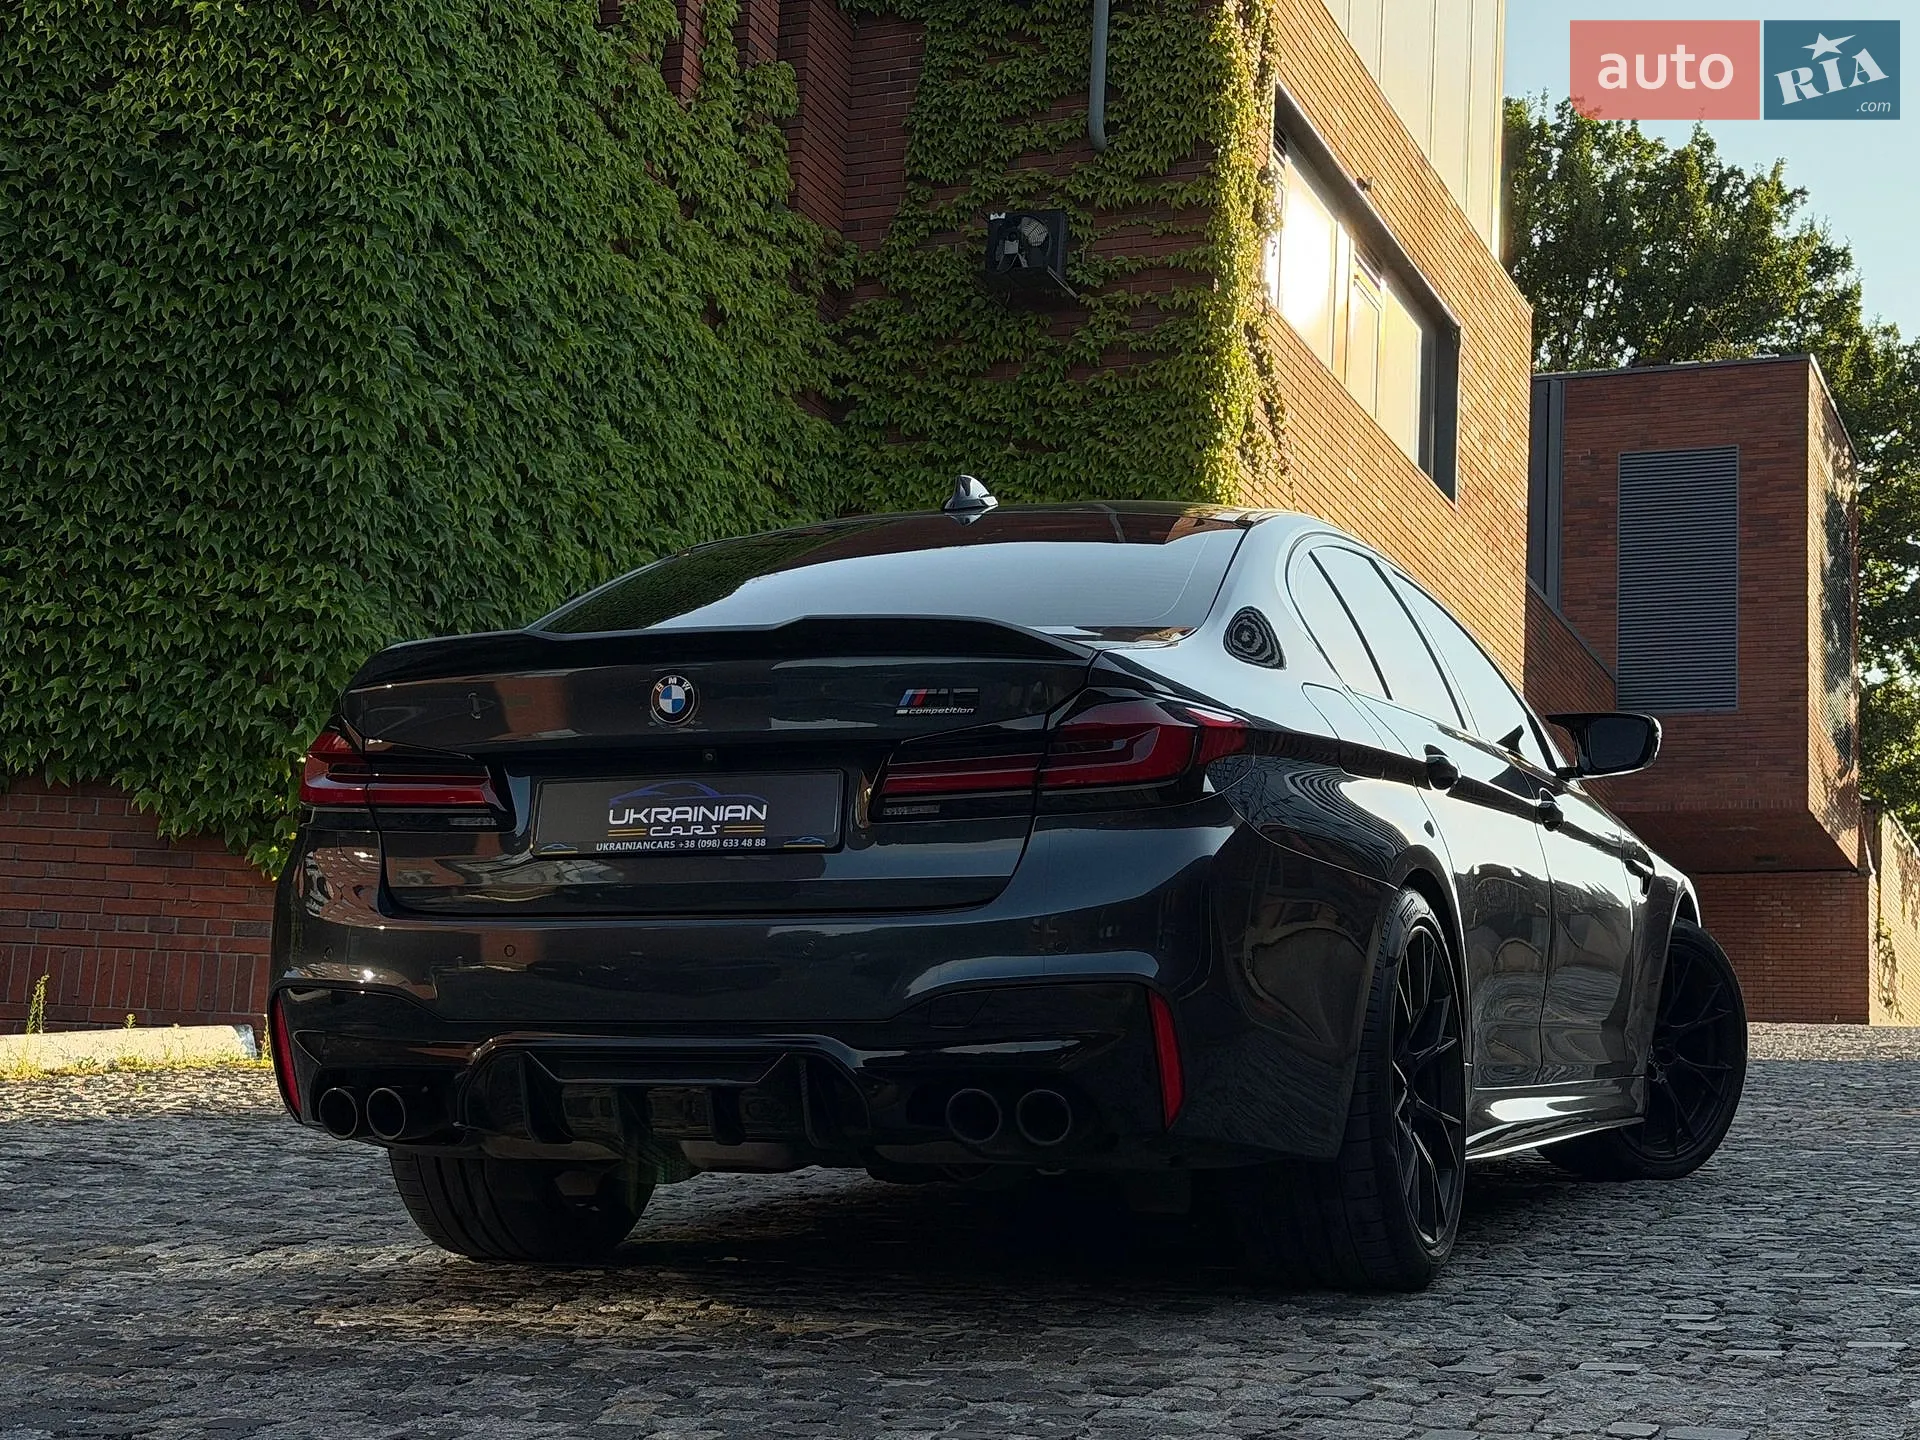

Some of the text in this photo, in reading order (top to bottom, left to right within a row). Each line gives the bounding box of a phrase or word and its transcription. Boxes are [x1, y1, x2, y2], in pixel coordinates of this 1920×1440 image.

[654, 676, 691, 692] BMW
[908, 706, 975, 715] competition
[608, 804, 768, 825] UKRAINIAN
[649, 825, 721, 837] CARS
[596, 837, 767, 852] UKRAINIANCARS +38 (098) 633 48 88
